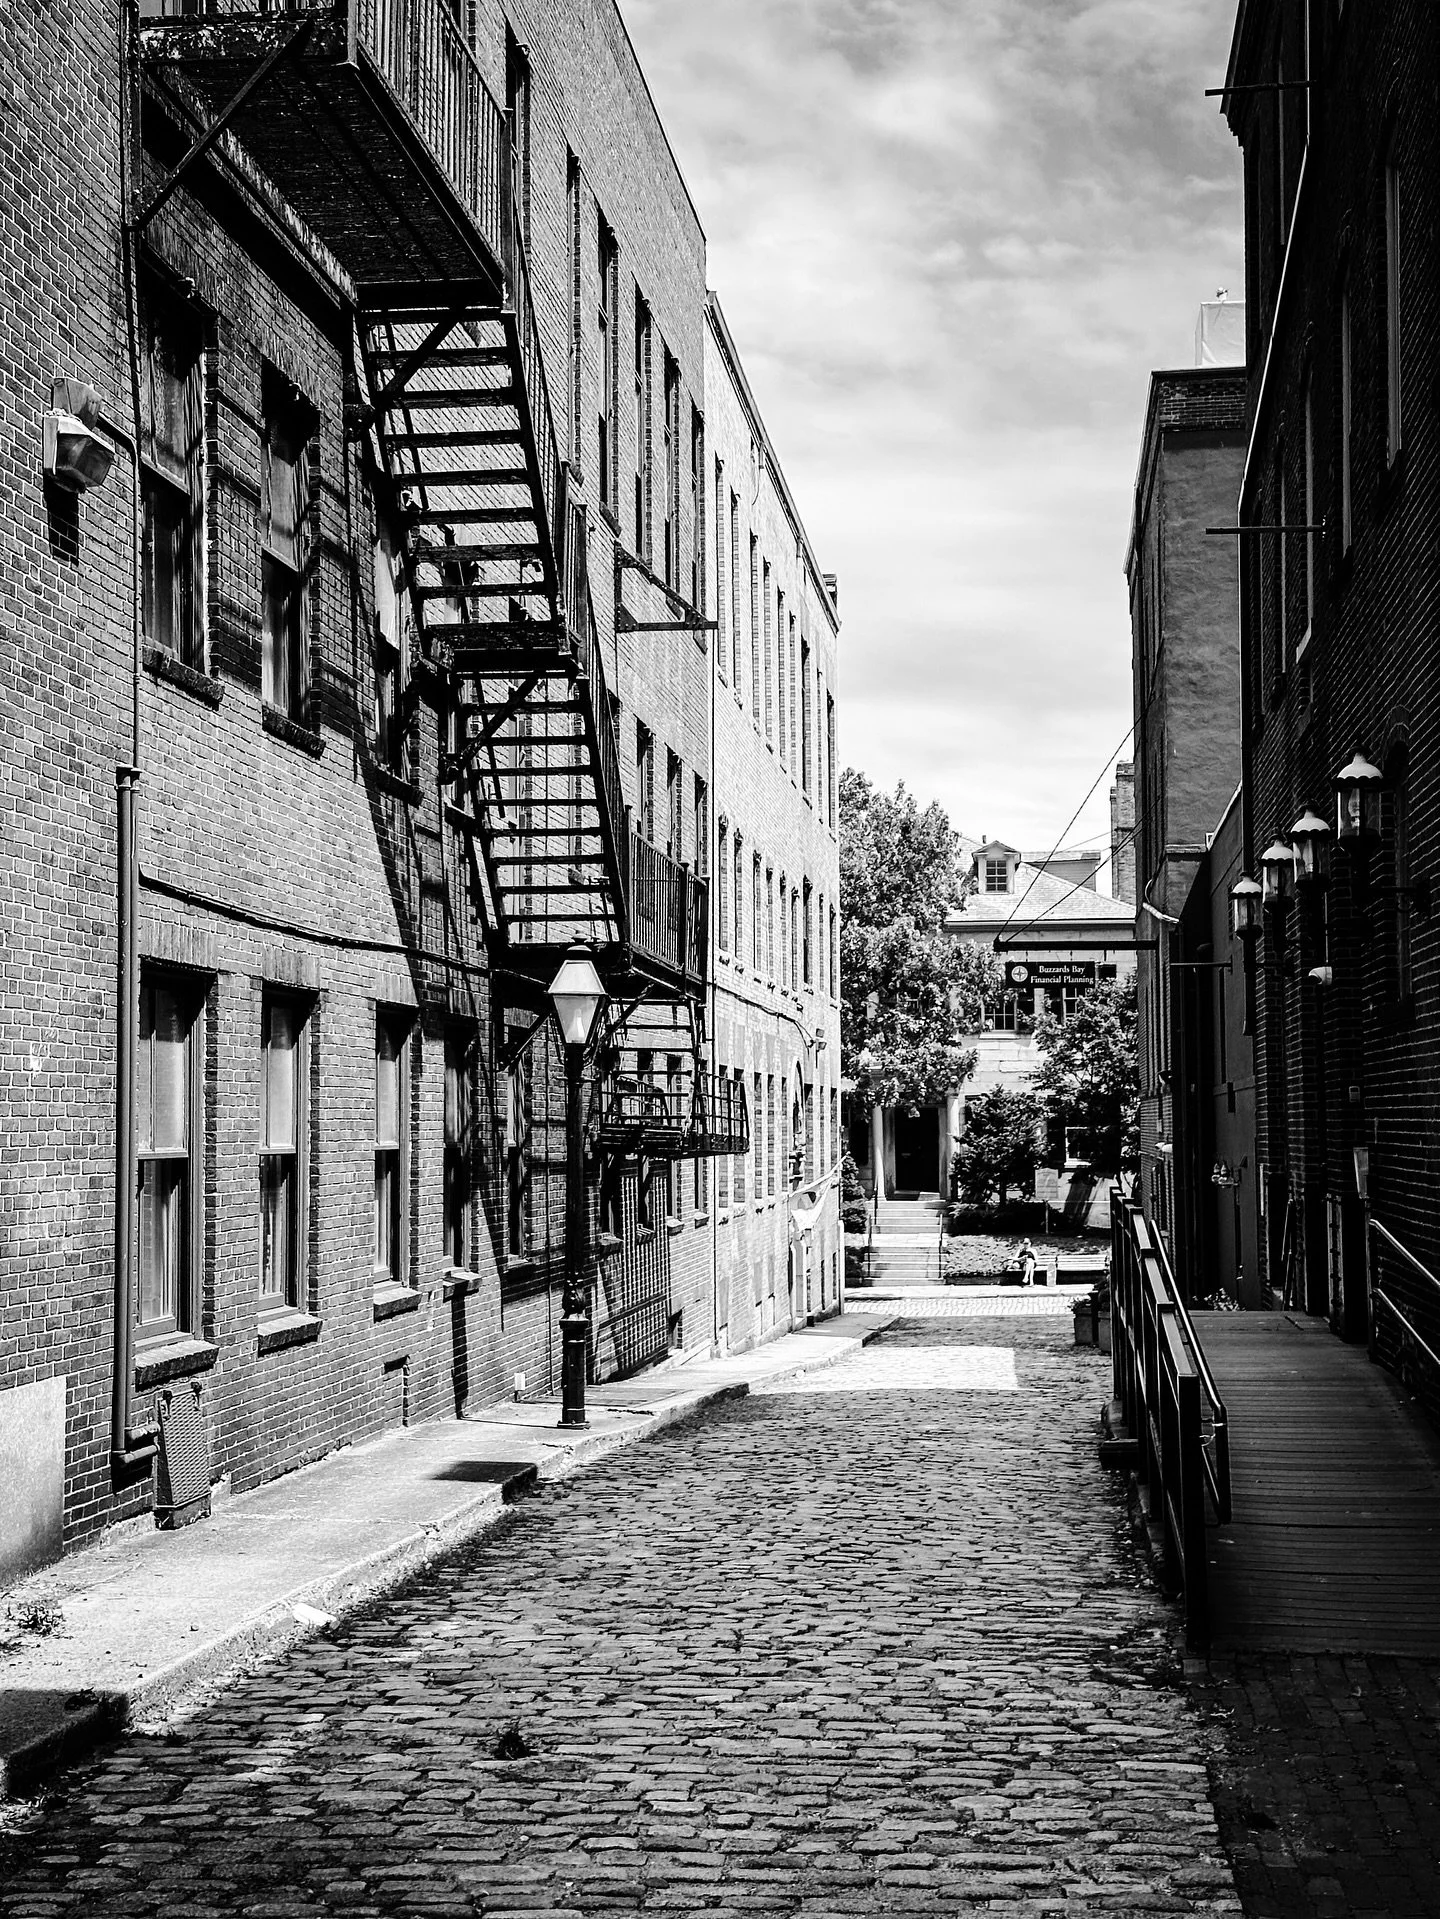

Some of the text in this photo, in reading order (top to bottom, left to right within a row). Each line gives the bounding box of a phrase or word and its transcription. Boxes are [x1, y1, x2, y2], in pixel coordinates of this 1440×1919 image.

[1039, 965, 1085, 974] Buzzards Bay
[1030, 975, 1094, 985] Financial Planning
